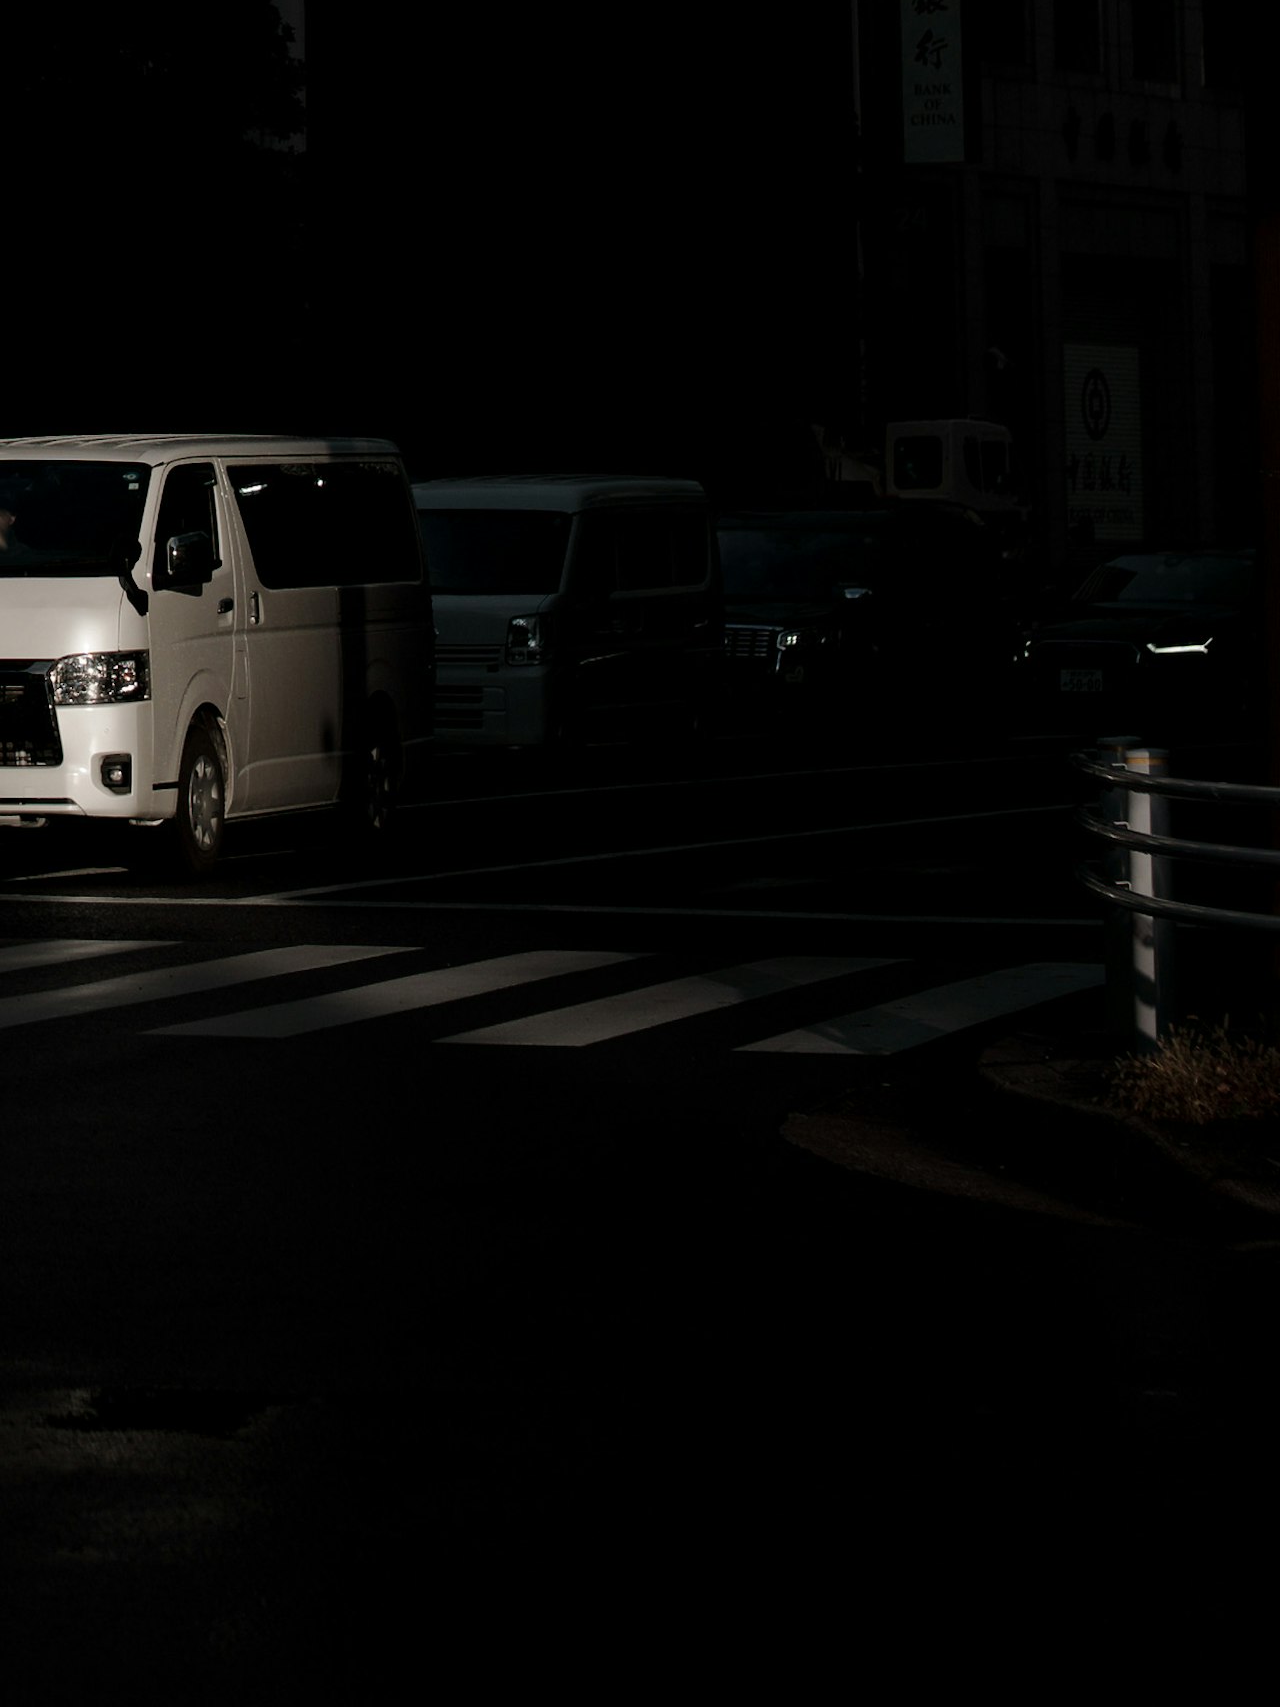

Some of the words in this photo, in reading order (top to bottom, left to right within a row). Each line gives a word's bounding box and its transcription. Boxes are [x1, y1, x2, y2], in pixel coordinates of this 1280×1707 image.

[913, 84, 952, 96] BANK
[924, 98, 944, 110] OF
[911, 113, 957, 126] CHINA
